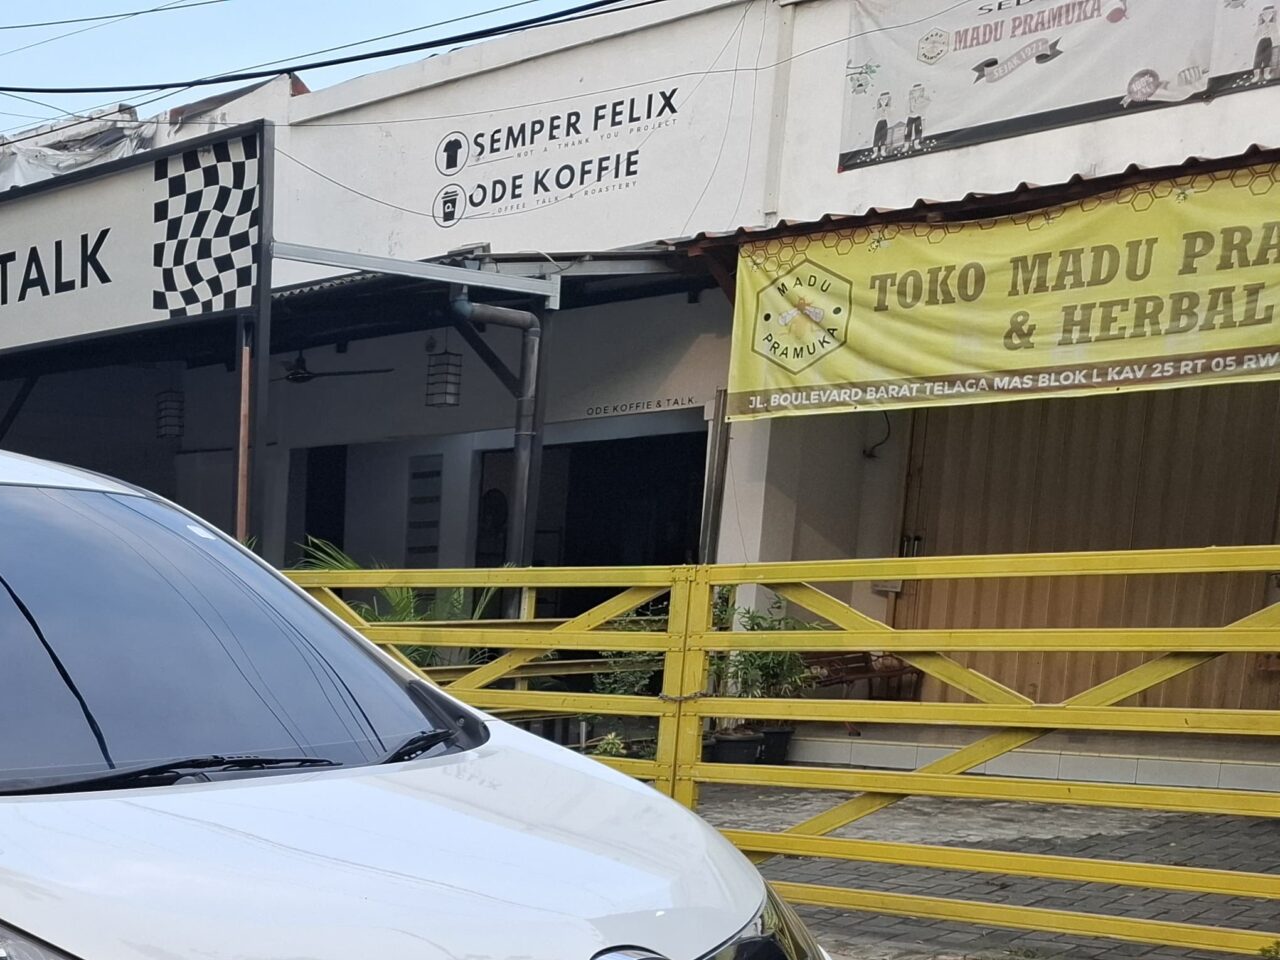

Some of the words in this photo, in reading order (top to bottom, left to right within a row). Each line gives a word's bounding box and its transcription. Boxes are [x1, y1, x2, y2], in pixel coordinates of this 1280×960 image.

[953, 20, 1005, 51] MADU
[1010, 0, 1102, 38] PRAMUKA
[473, 111, 582, 157] SEMPER
[593, 87, 679, 132] FELIX
[516, 149, 534, 159] NOT
[557, 137, 591, 150] THANK
[600, 131, 620, 142] YOU
[629, 118, 678, 135] PROJECT
[469, 174, 524, 208] ODE
[532, 149, 640, 195] KOFFIE
[535, 194, 560, 206] TALK
[583, 180, 639, 197] ROASTERY
[777, 275, 832, 297] MADU
[870, 261, 986, 313] TOKO
[1007, 237, 1159, 297] MADU
[1003, 310, 1037, 351] &
[1057, 282, 1275, 346] HERBAL
[763, 326, 838, 359] PRAMUKA
[748, 395, 767, 409] JL.
[770, 387, 862, 407] BOULEVARD
[866, 382, 919, 399] BARAT
[923, 378, 990, 396] TELAGA
[993, 374, 1033, 391] MAS
[1037, 369, 1088, 388] BLOK
[1092, 367, 1102, 383] L
[1106, 364, 1148, 382] KAV
[1150, 361, 1174, 378] 25
[1179, 358, 1207, 375] RT
[1210, 356, 1237, 372] 05
[1242, 352, 1280, 370] RW
[586, 405, 609, 416] ODE
[612, 400, 652, 413] KOFFIE
[655, 399, 662, 408] &
